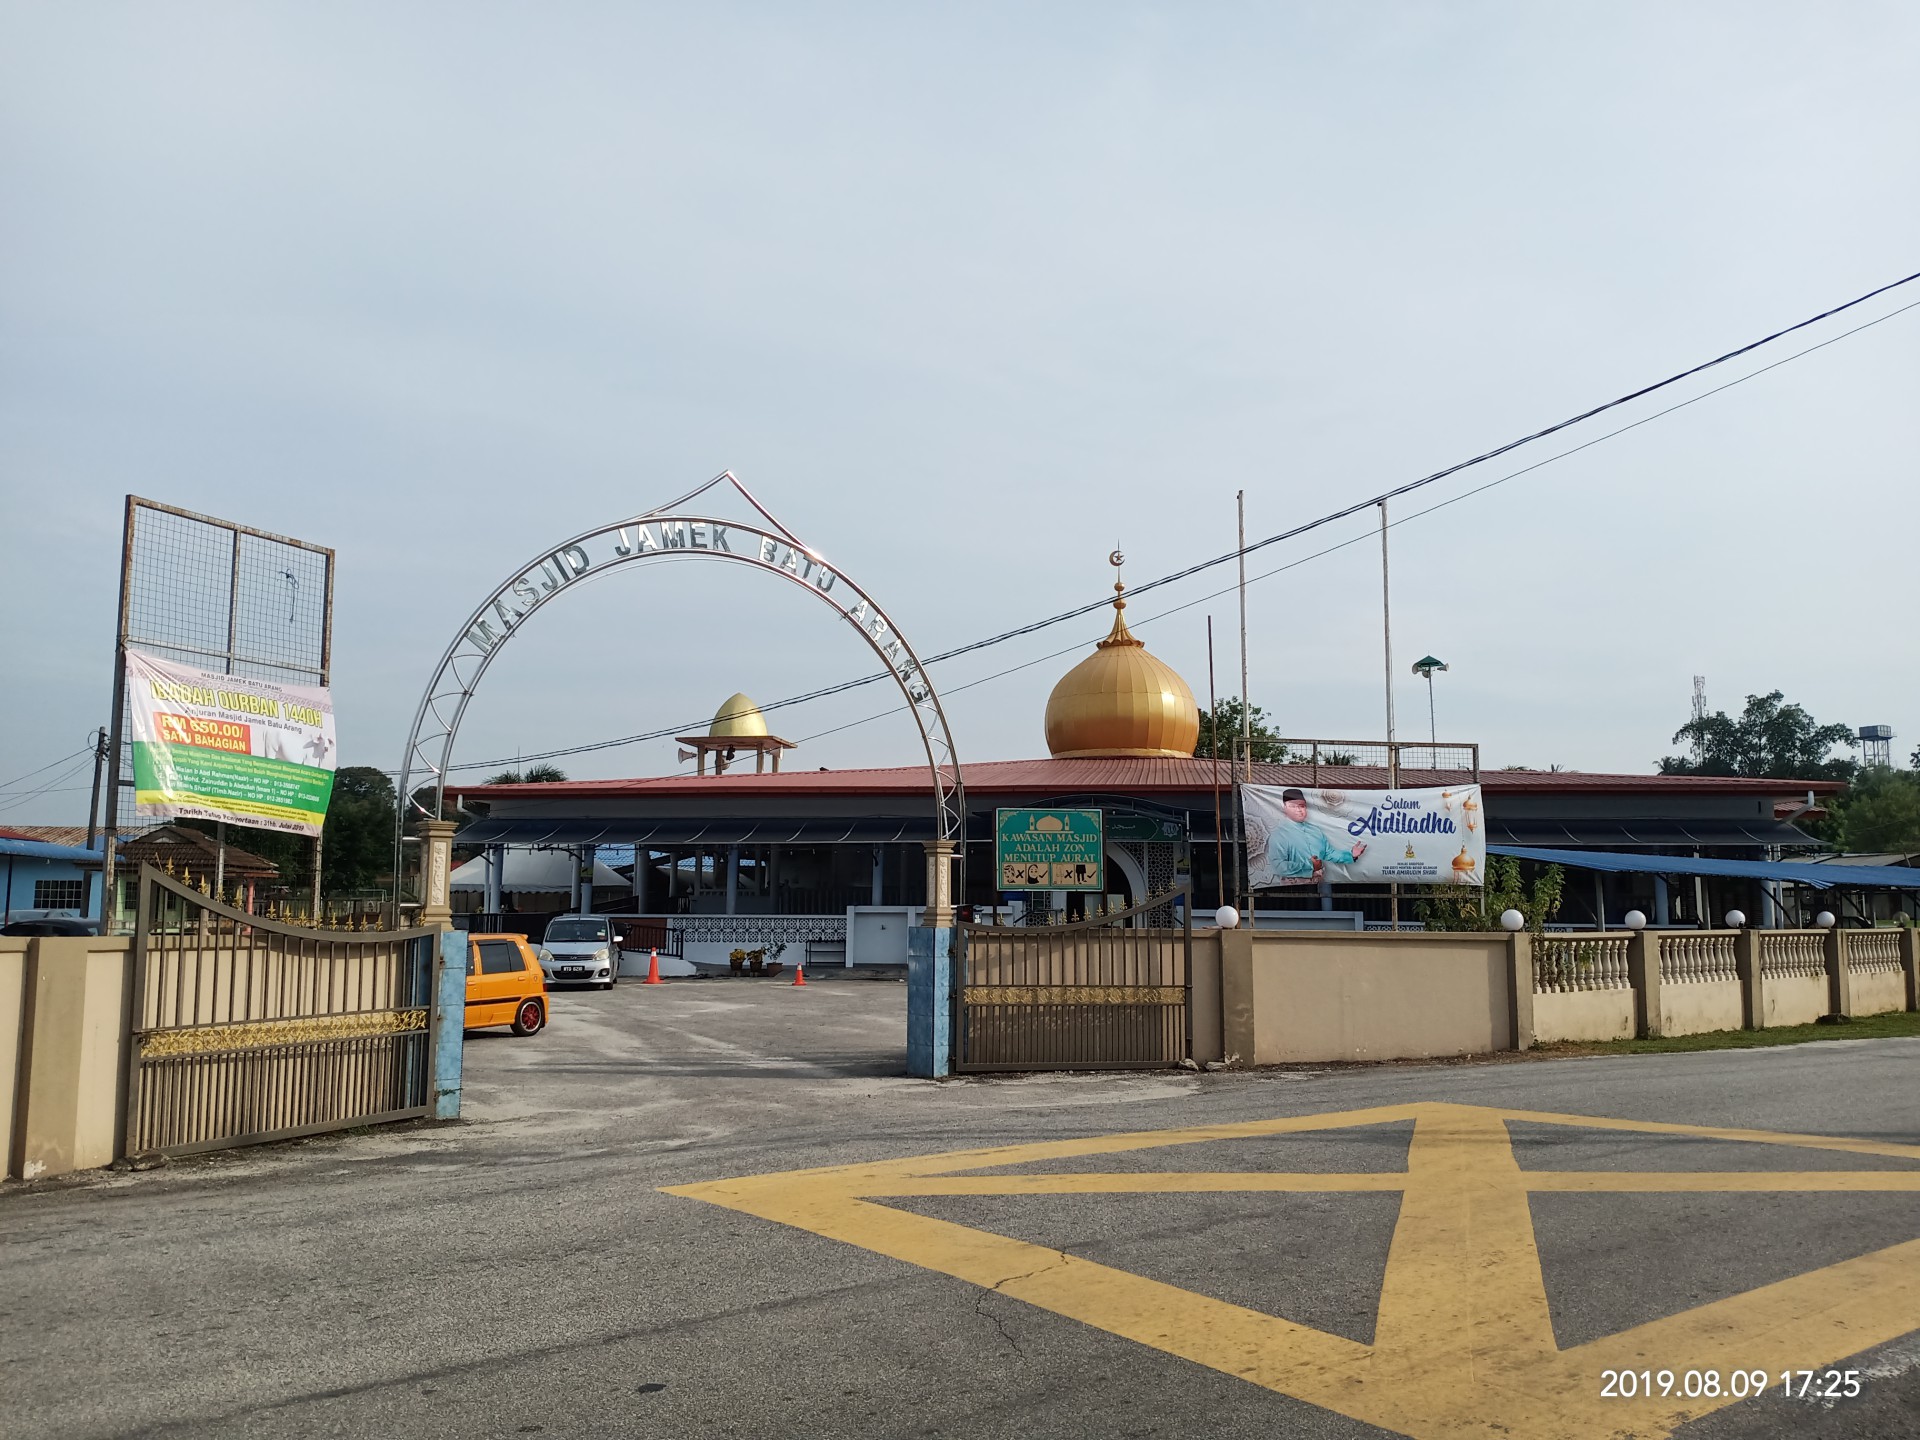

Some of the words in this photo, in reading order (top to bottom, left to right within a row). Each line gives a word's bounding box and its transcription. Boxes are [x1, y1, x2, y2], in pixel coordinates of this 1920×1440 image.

[465, 545, 590, 655] MASJID
[615, 521, 731, 557] JAMEK
[759, 535, 837, 593] BATU
[848, 599, 930, 704] ARANG
[201, 672, 225, 682] MASJID
[227, 675, 247, 685] JAMEK
[248, 679, 263, 689] BATU
[264, 682, 283, 693] ARANG
[219, 691, 279, 718] QURBAN
[283, 702, 324, 729] 1440H
[162, 715, 187, 729] RM
[219, 711, 243, 724] Masjid
[244, 716, 266, 727] Jamek
[267, 719, 283, 728] Batu
[284, 723, 303, 735] Arang
[162, 729, 192, 744] SATU
[195, 734, 247, 752] BAHAGIAN
[199, 768, 211, 776] Abd
[262, 778, 270, 786] HP
[193, 784, 211, 793] Sharif
[1381, 794, 1421, 811] Salam
[178, 807, 203, 816] Tarikh
[278, 822, 292, 830] Julai
[1347, 807, 1457, 837] Aidiladha
[1002, 833, 1053, 842] KAWASAN
[1056, 833, 1098, 843] MASJID
[1015, 843, 1060, 852] ADALAH
[1064, 843, 1085, 852] ZON
[1004, 853, 1056, 862] MENUTUP
[1061, 854, 1096, 862] AURAT
